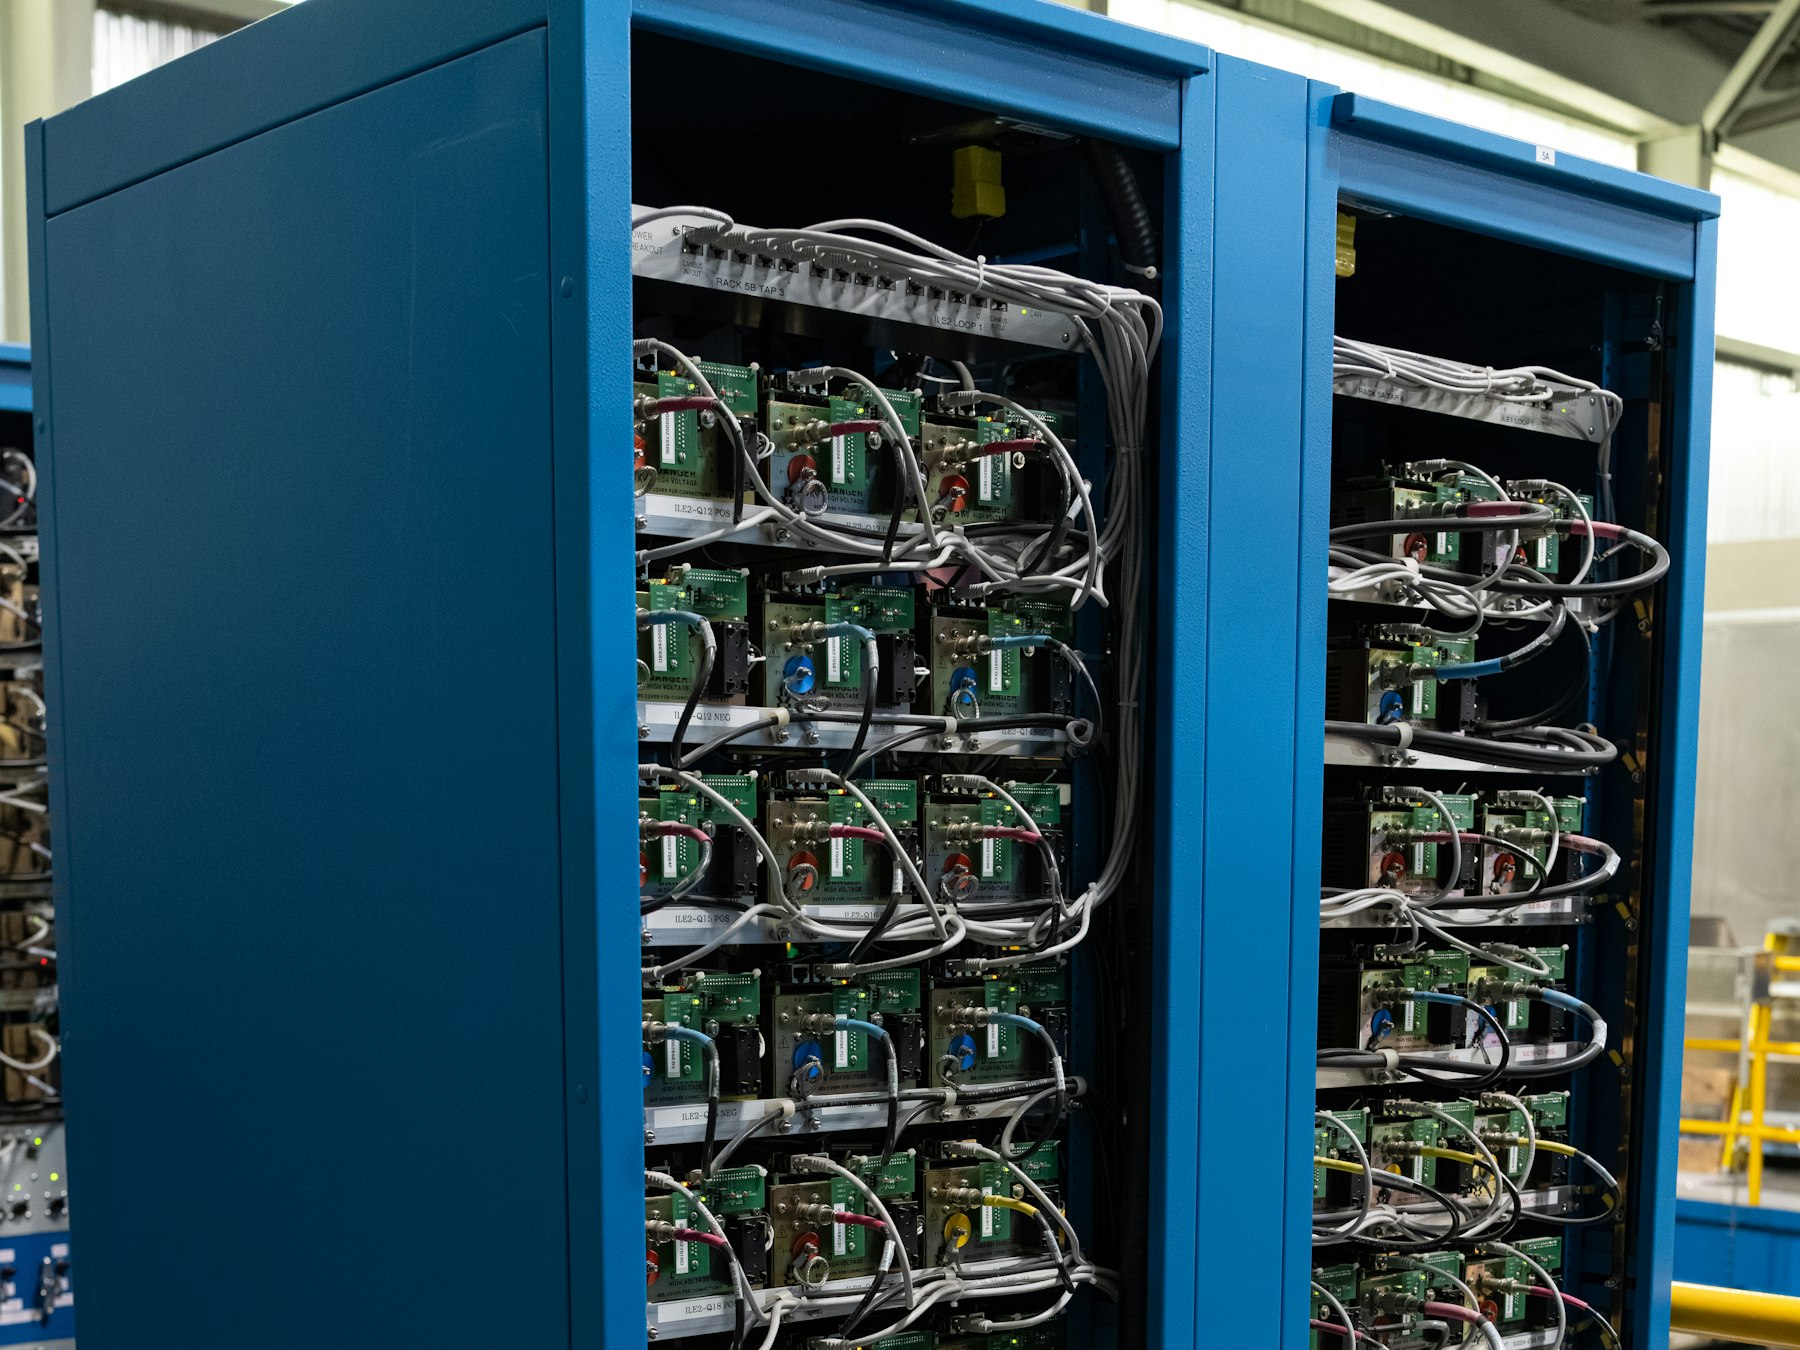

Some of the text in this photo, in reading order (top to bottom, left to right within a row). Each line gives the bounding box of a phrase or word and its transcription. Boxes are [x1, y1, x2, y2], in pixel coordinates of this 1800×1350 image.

[1542, 152, 1550, 160] 5A
[632, 231, 652, 240] OWER
[716, 278, 785, 296] RACK 5B TAP 3
[934, 316, 952, 326] ILE2
[954, 318, 976, 329] LOOP
[1358, 388, 1375, 397] RACK
[671, 478, 697, 486] VOLTAGE
[674, 504, 731, 518] ILE2-Q12 POS
[984, 692, 1017, 701] DANGER
[674, 711, 731, 722] IL-Q12 NEG
[675, 914, 730, 924] ILE2-Q15 POS
[721, 1108, 737, 1117] NEG
[684, 1277, 708, 1285] VOLTAGE
[685, 1302, 722, 1314] ILE2-Q18
